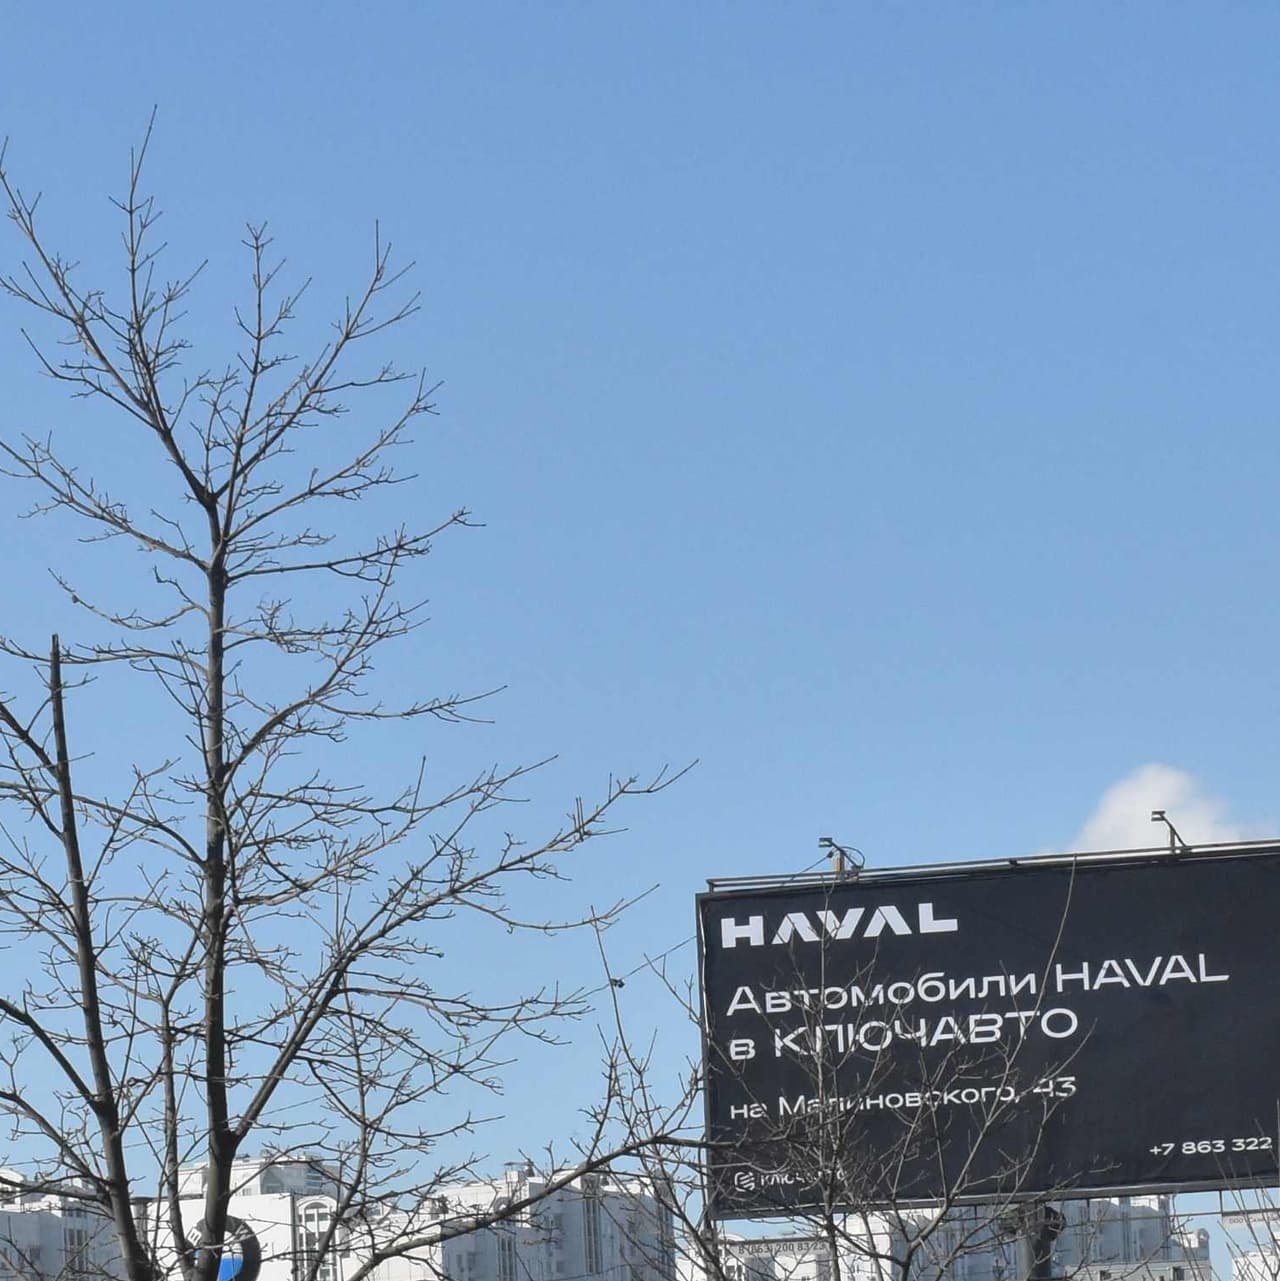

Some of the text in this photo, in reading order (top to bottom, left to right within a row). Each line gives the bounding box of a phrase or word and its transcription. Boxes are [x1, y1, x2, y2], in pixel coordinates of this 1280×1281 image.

[721, 902, 959, 949] HAVAL
[726, 953, 1230, 1016] Автомобили HAVAL
[729, 1007, 1078, 1060] в КЛЮЧАВТО
[730, 1103, 767, 1119] на
[1149, 1143, 1175, 1156] +7
[1181, 1139, 1225, 1154] 863
[1231, 1137, 1273, 1151] 322
